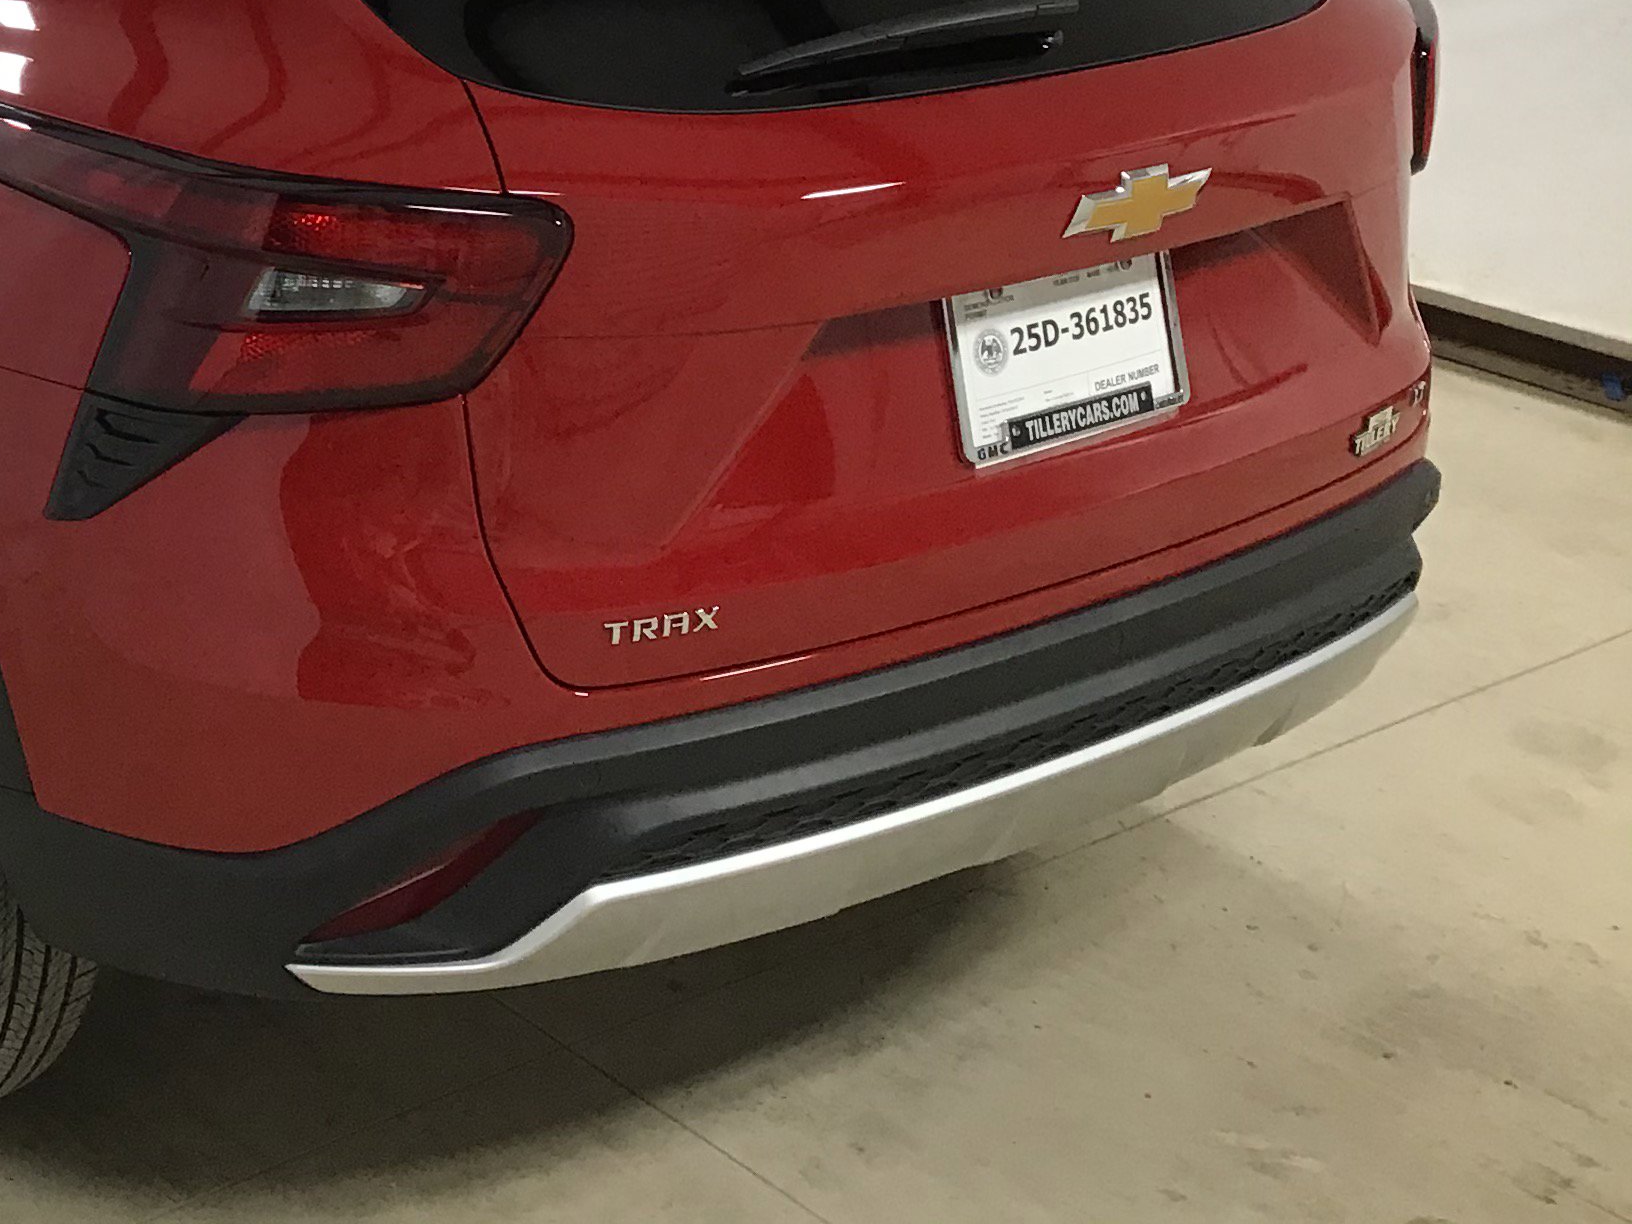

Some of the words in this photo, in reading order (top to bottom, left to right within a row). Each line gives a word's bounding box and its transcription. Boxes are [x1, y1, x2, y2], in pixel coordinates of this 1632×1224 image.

[1011, 292, 1152, 356] 25D-361835
[1094, 373, 1127, 392] DEALER
[1127, 363, 1160, 382] NUMBER
[1025, 392, 1139, 441] TILLERYCARS.COM
[604, 605, 719, 645] TRAX
